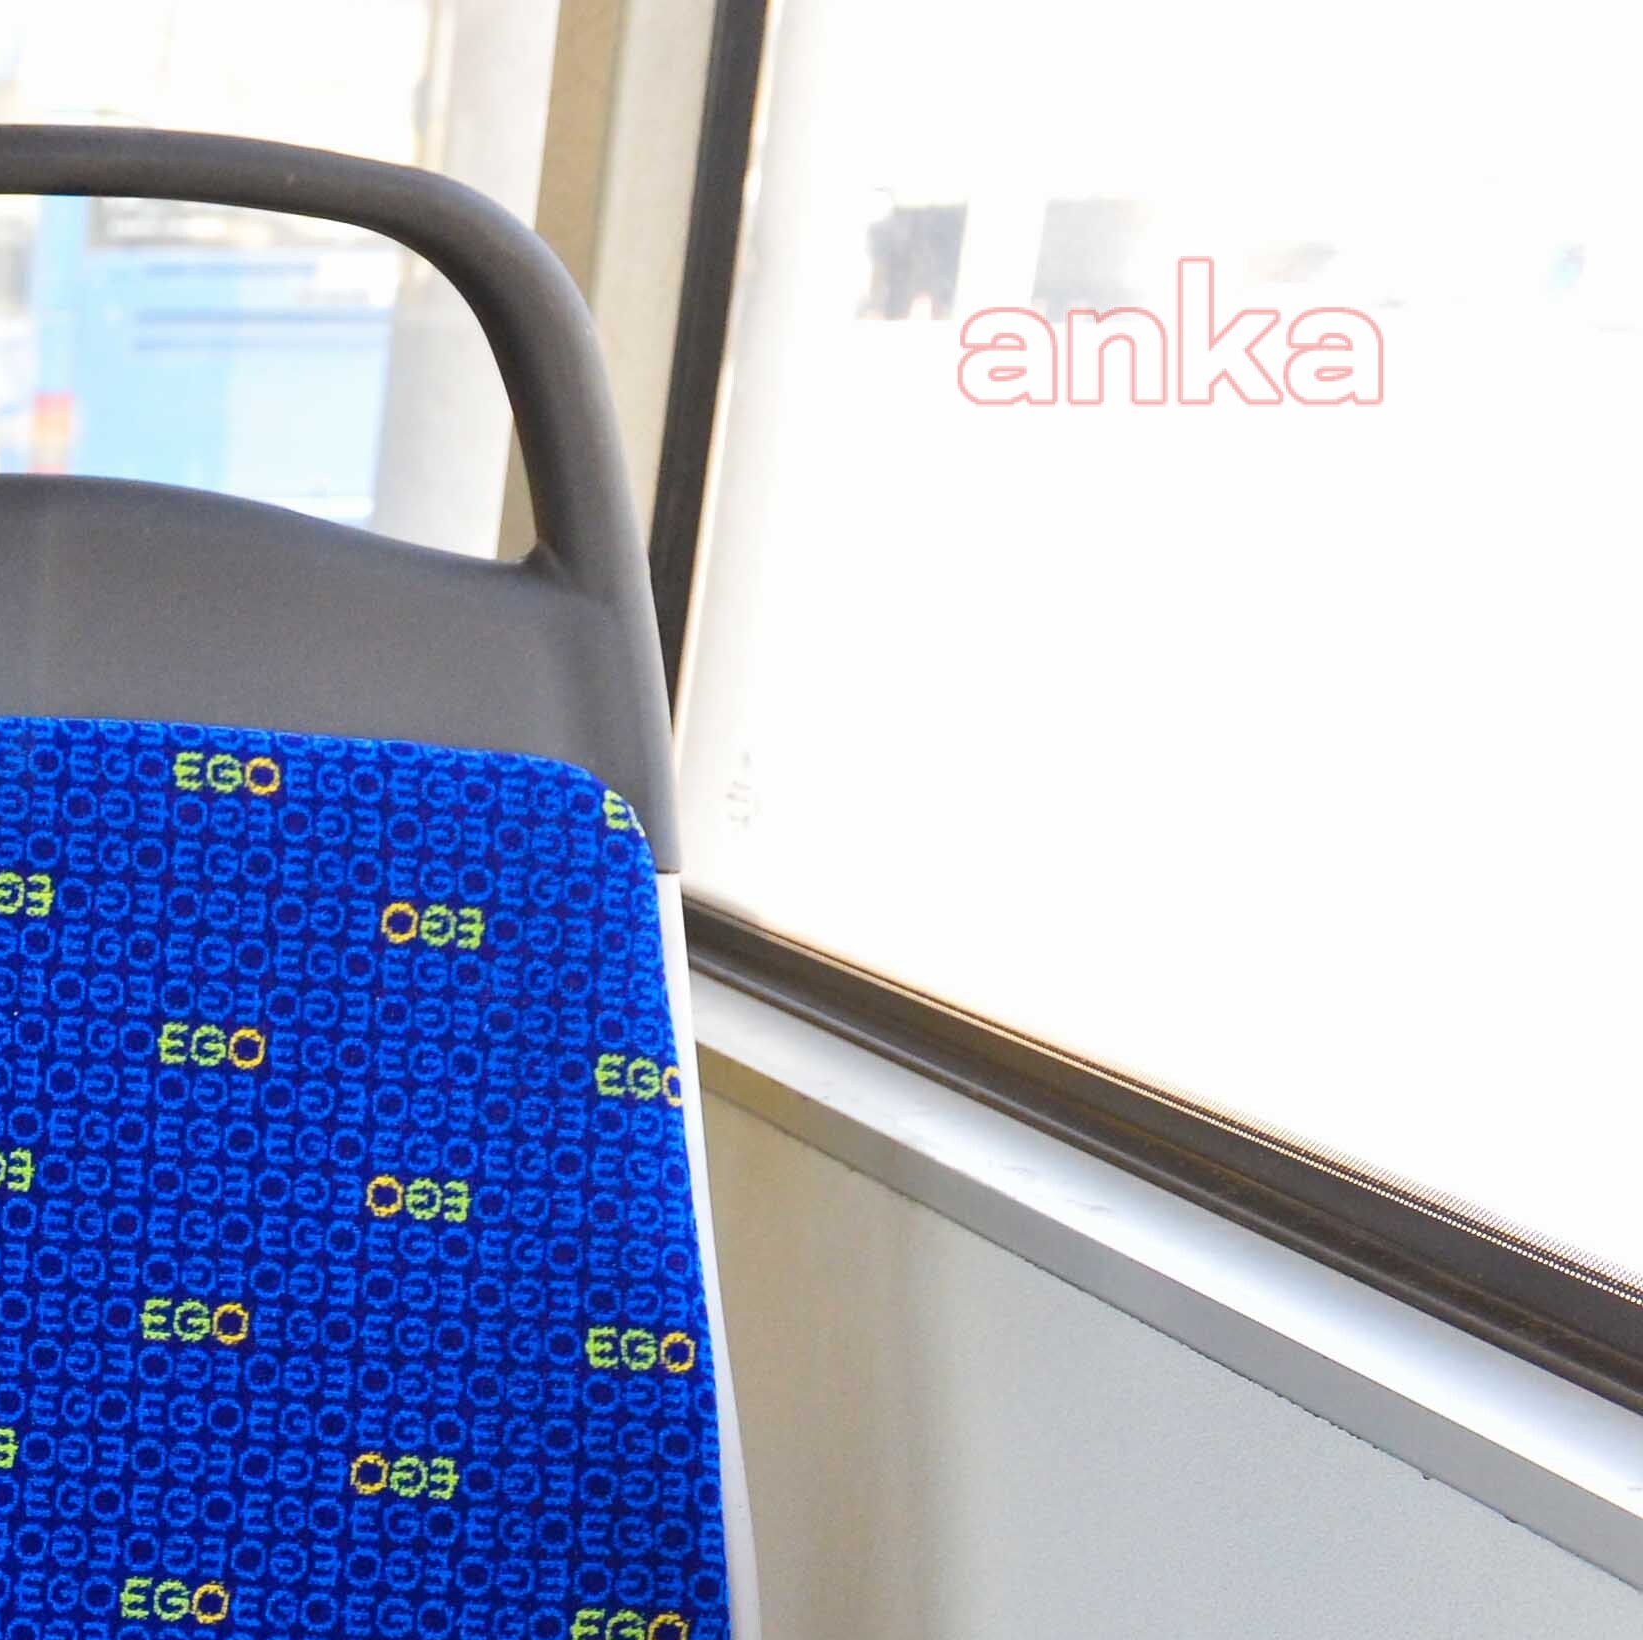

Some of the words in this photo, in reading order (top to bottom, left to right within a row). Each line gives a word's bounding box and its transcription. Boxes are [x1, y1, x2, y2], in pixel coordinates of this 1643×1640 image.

[174, 753, 279, 794] EGO
[159, 1023, 265, 1068] EGO
[142, 1299, 249, 1344] EGO
[586, 1328, 694, 1372] EGO
[121, 1578, 229, 1623] EGO
